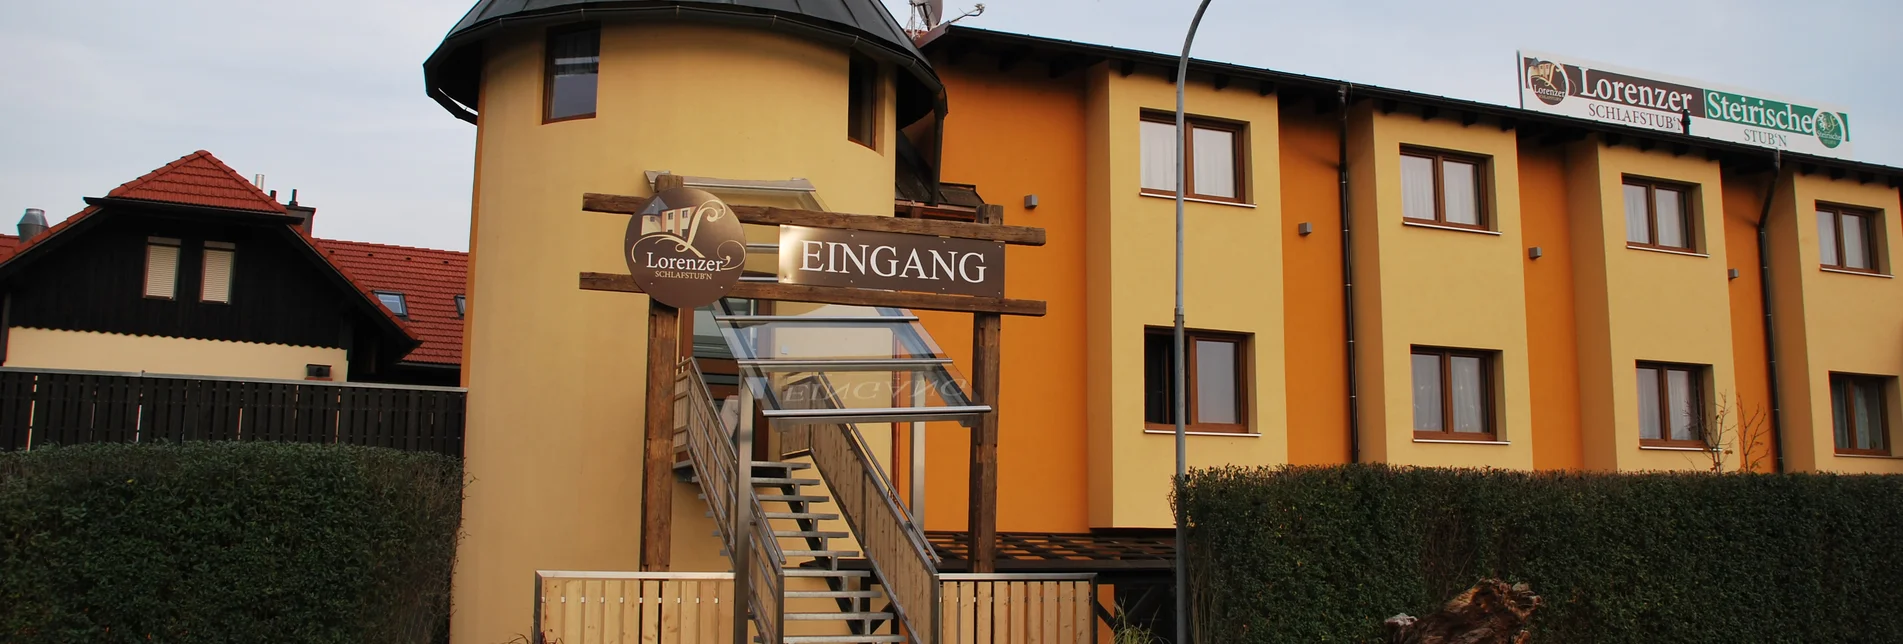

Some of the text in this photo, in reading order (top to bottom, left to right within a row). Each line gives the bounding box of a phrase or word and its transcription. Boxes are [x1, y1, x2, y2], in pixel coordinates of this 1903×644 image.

[1534, 85, 1565, 97] Lorenzer
[1579, 67, 1692, 113] Lorenzer
[1708, 92, 1812, 133] Steirische
[646, 252, 723, 271] Lorenzer
[801, 241, 987, 283] EINGANG
